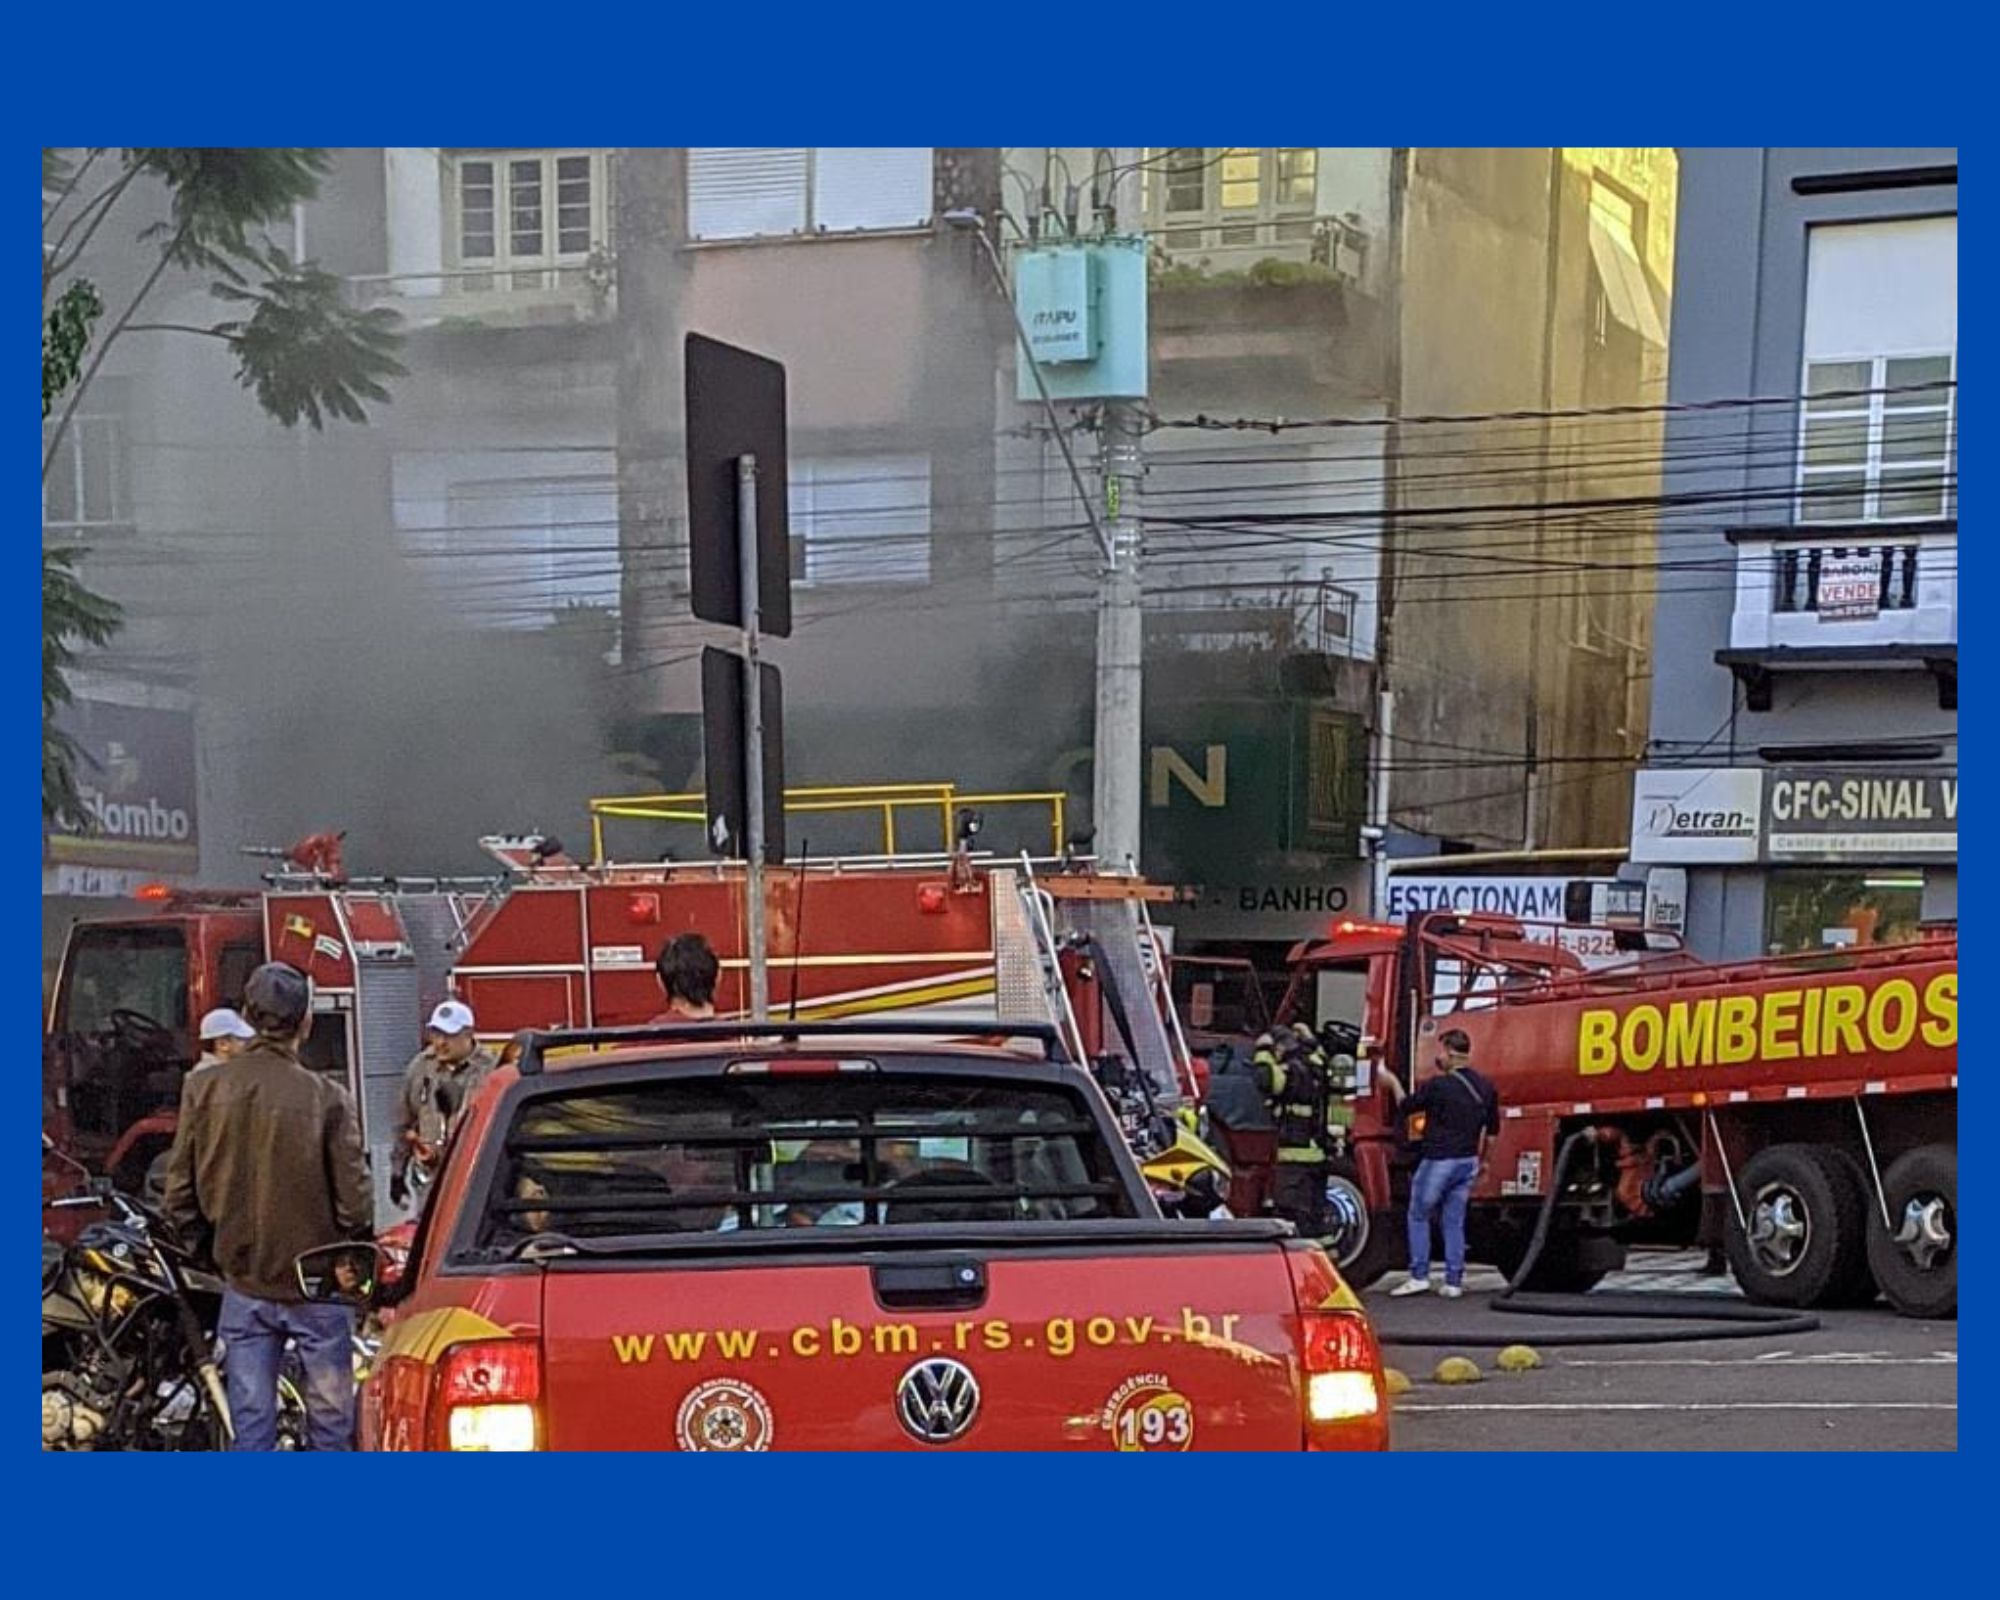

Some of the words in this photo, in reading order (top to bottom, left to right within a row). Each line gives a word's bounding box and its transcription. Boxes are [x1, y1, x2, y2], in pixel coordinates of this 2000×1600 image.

[1821, 583, 1877, 600] VENDE
[1772, 779, 1932, 820] CFC-SINAL
[1239, 885, 1348, 912] BANHO
[1578, 973, 1957, 1075] BOMBEIROS
[611, 1306, 1240, 1363] www.cbm.rs.gov.br
[1119, 1406, 1190, 1443] 193
